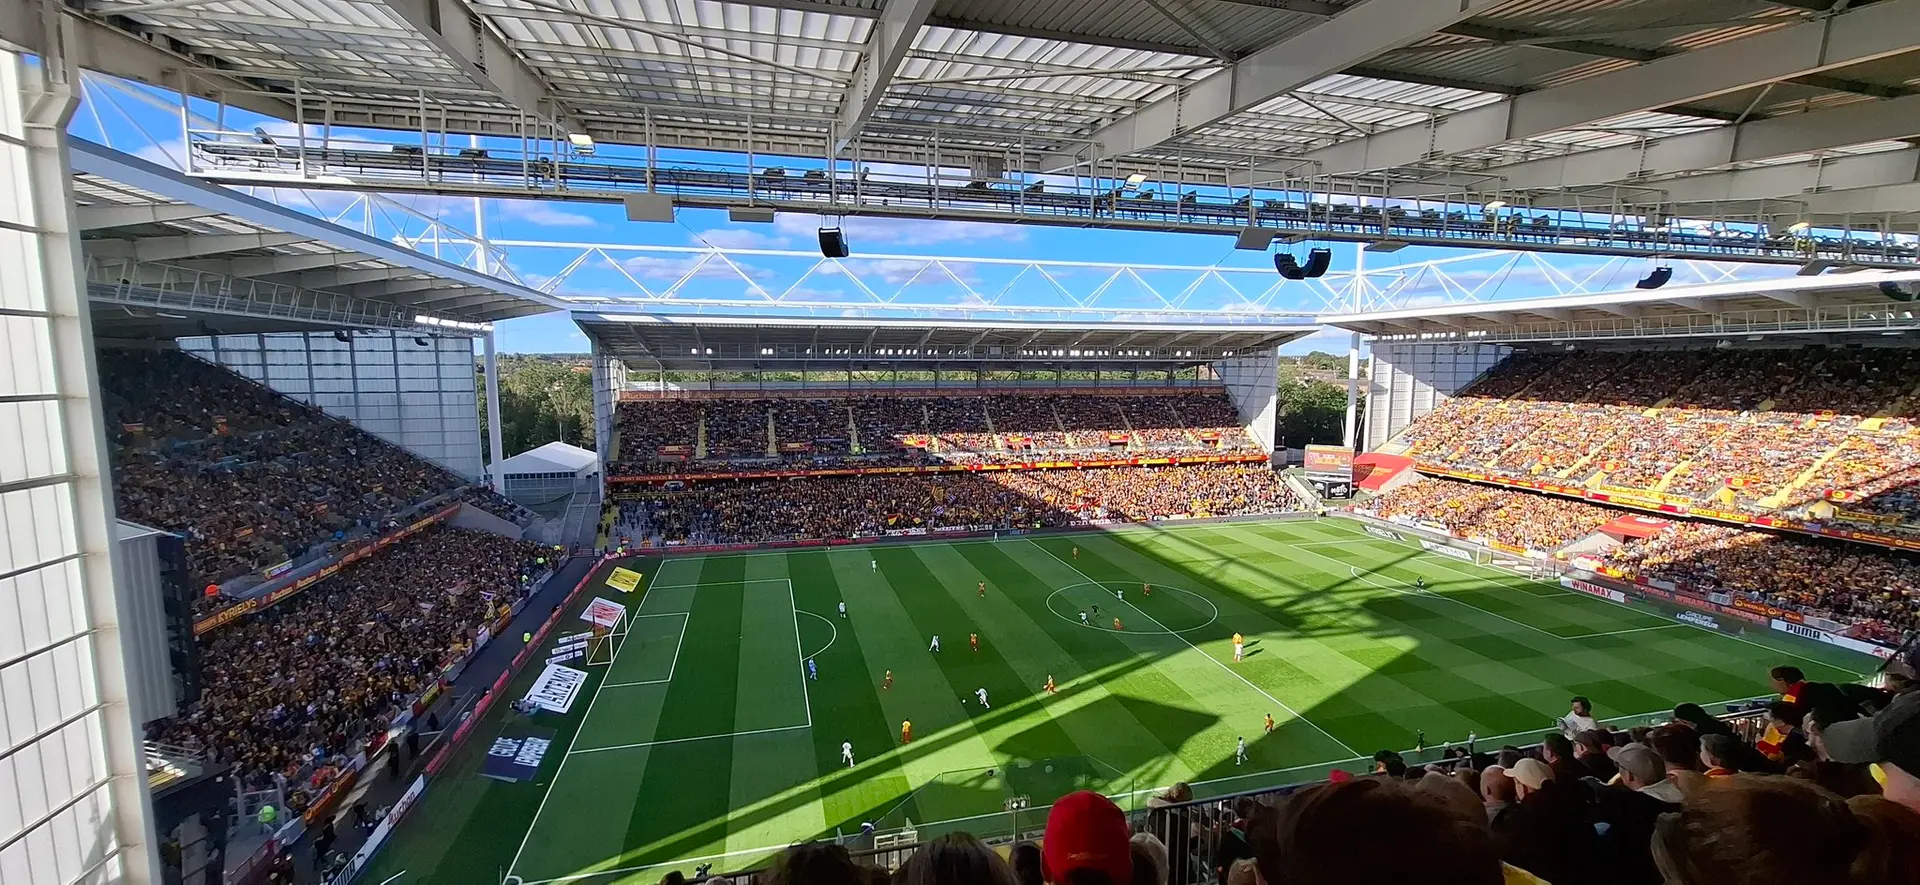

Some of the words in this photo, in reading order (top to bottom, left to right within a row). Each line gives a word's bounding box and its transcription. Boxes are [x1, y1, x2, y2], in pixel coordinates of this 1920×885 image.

[729, 390, 760, 398] Auchan
[1571, 579, 1613, 599] WINAMAX
[218, 599, 257, 623] KYRIELYS
[1785, 623, 1821, 640] PUMA
[535, 667, 579, 705] ARTEMIS
[387, 790, 416, 831] Auchan
